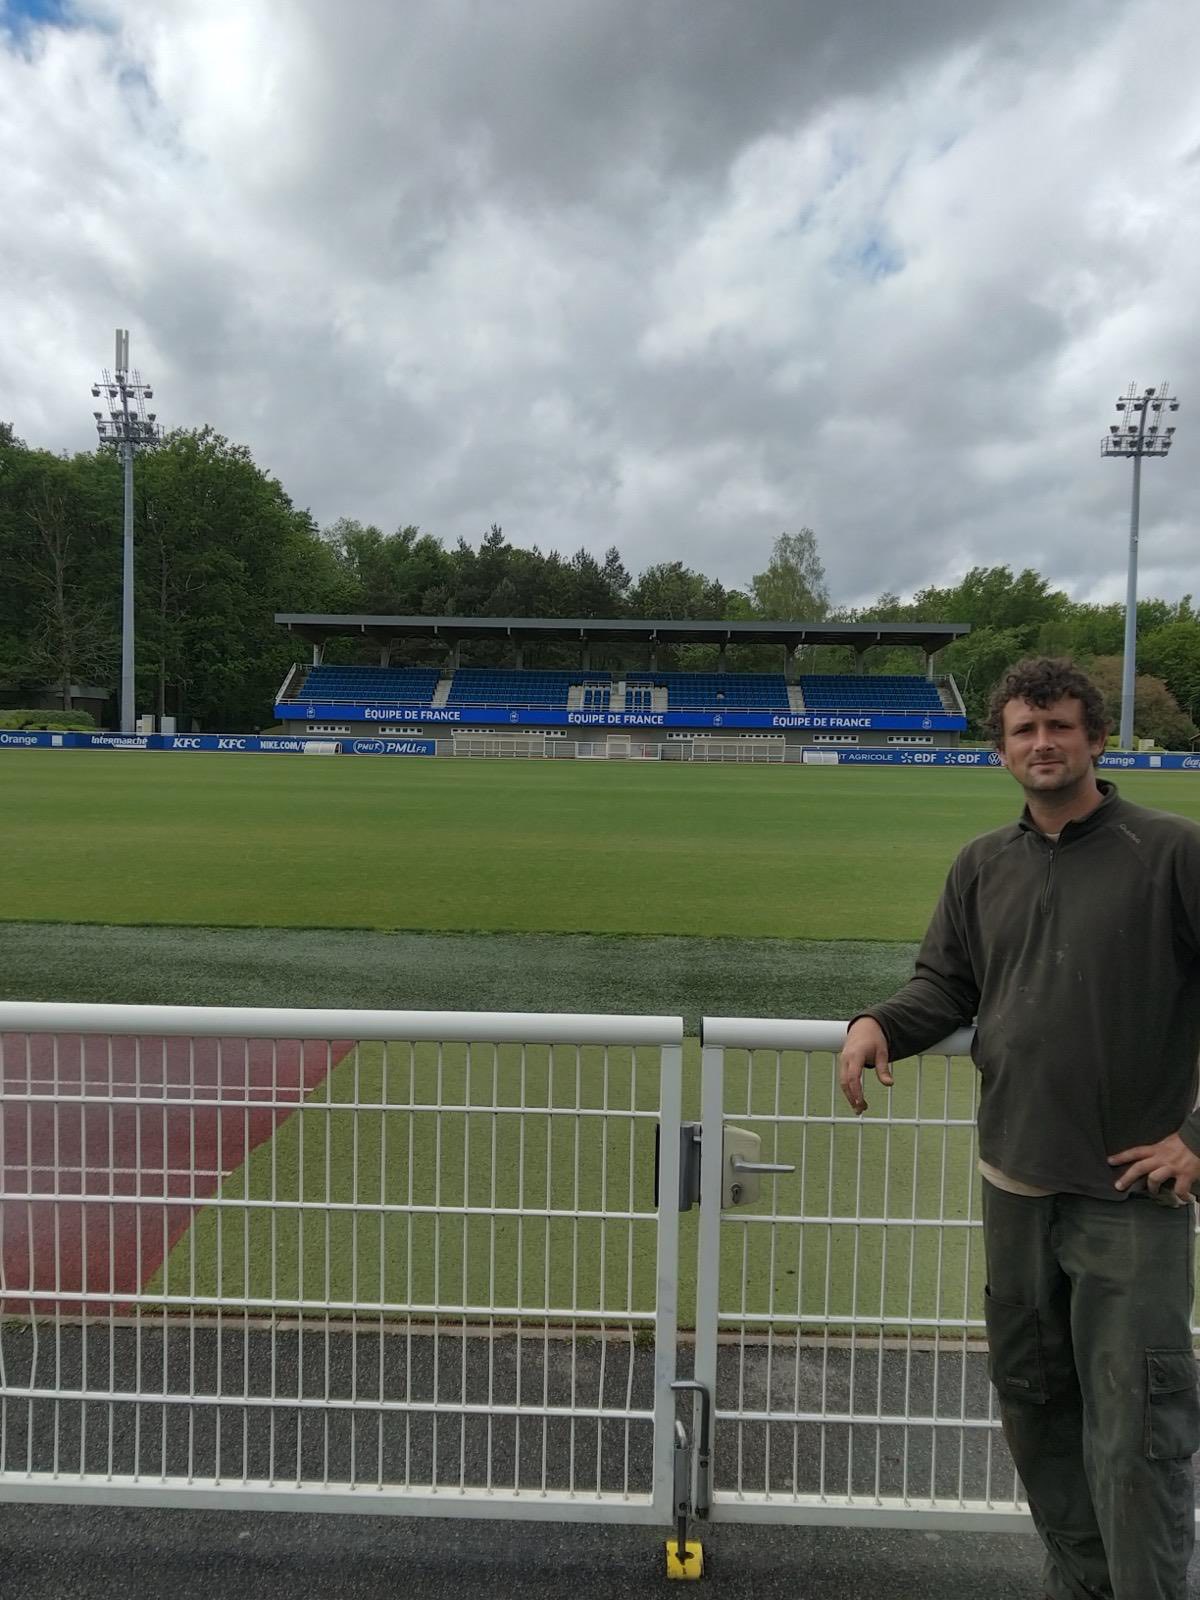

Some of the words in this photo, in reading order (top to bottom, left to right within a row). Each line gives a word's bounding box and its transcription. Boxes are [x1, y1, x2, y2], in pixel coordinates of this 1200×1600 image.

[364, 708, 402, 719] ÉQUIPE
[404, 711, 418, 719] DE
[420, 711, 461, 720] FRANCE
[567, 712, 605, 724] ÉQUIPE
[607, 715, 622, 724] DE
[624, 715, 664, 724] FRANCE
[772, 715, 811, 727] ÉQUIPE
[813, 717, 828, 726] DE
[829, 718, 872, 727] FRANCE
[0, 734, 38, 745] Orange
[173, 738, 201, 748] KFC
[217, 739, 246, 749] KFC
[1098, 756, 1135, 766] Orange
[1182, 756, 1200, 768] Coca
